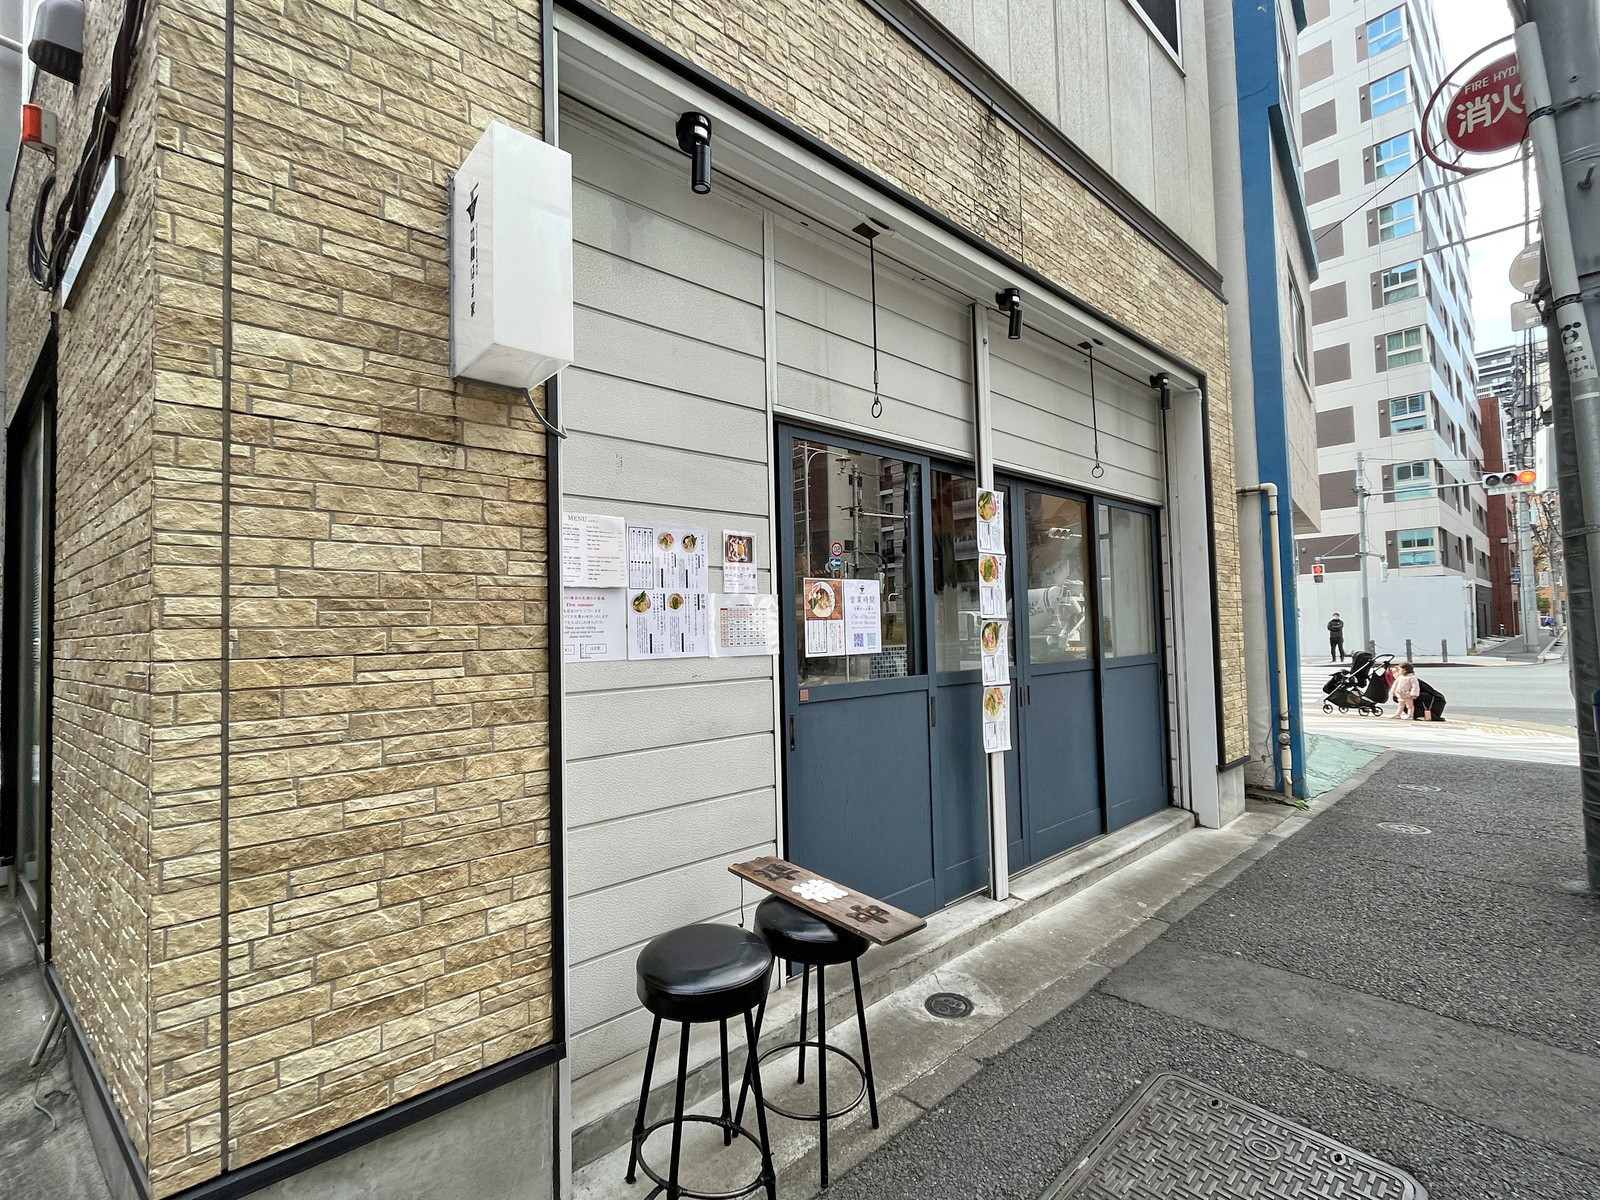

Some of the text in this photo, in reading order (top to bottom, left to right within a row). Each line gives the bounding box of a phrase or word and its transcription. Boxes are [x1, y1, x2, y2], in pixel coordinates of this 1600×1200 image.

[1464, 65, 1519, 95] FIRE HYD
[1457, 83, 1526, 137] 消火
[568, 514, 587, 523] MENU
[850, 596, 875, 604] 営業時間
